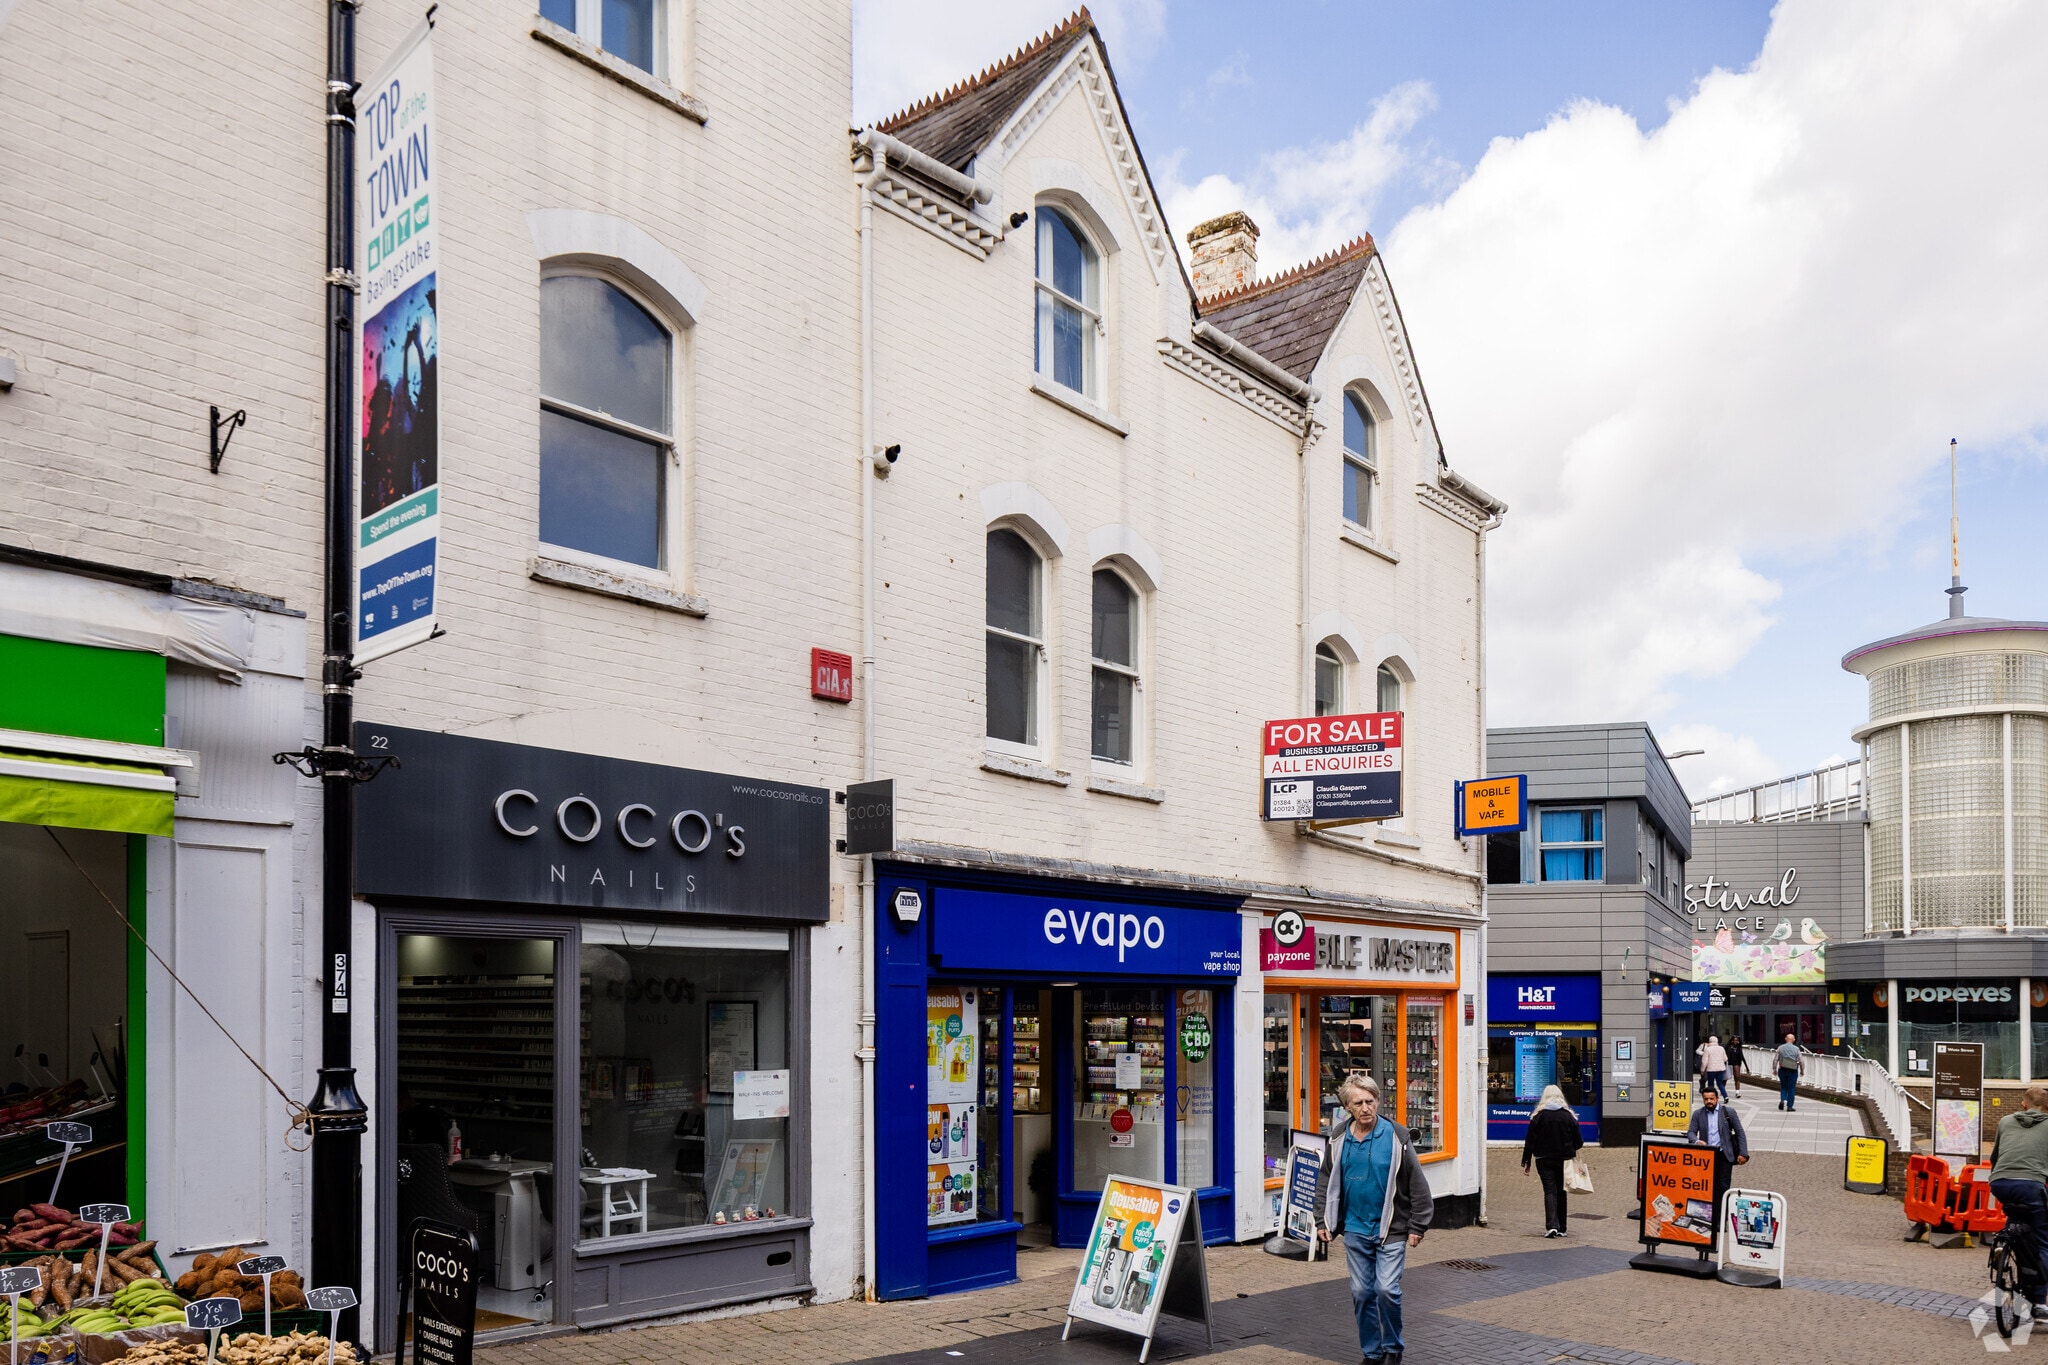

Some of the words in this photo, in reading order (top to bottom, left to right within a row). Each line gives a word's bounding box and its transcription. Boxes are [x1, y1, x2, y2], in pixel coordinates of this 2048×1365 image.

[365, 79, 400, 161] TOP
[400, 105, 410, 131] of
[411, 91, 427, 119] the
[367, 123, 429, 229] TOWN
[367, 240, 431, 304] Basingstoke
[369, 518, 389, 539] Spend
[389, 514, 400, 527] the
[400, 503, 427, 523] evening
[362, 564, 433, 601] www.TopOfTheTown.org
[817, 666, 841, 694] CIA
[1270, 723, 1321, 747] FOR
[1328, 718, 1395, 742] SALE
[371, 735, 388, 749] 22
[1285, 746, 1323, 756] BUSINESS
[1324, 743, 1378, 754] UNAFFECTED
[1271, 758, 1300, 774] ALL
[1304, 755, 1393, 772] ENQUIRIES
[732, 784, 823, 805] www.cocosnails.co
[1472, 786, 1511, 799] MOBILE
[1488, 799, 1496, 808] &
[493, 788, 746, 858] COCO's
[1479, 810, 1505, 820] VAPE
[853, 821, 886, 831] NAILS
[550, 864, 696, 892] NAILS
[900, 896, 917, 906] hns
[1698, 917, 1765, 931] LACE
[1043, 908, 1165, 962] evapo
[1210, 951, 1223, 959] your
[1224, 950, 1241, 959] local
[1267, 951, 1310, 965] payzone
[1369, 937, 1454, 972] MASTER
[336, 955, 346, 995] 374
[1203, 962, 1221, 973] vape
[1223, 961, 1241, 974] shop
[1518, 986, 1556, 1003] H&T
[1905, 986, 2012, 1002] POPEYES
[1084, 1002, 1131, 1011] Pre-Filled
[1187, 1015, 1205, 1023] Change
[1185, 1031, 1211, 1047] CBD
[1187, 1049, 1205, 1059] Today
[1658, 1091, 1686, 1100] CASH
[1657, 1109, 1687, 1119] GOLD
[1651, 1150, 1677, 1165] We
[1682, 1153, 1710, 1171] Buy
[1651, 1174, 1676, 1188] We
[1682, 1177, 1709, 1191] Sell
[1109, 1191, 1159, 1215] Reusable
[421, 1278, 459, 1298] NAILS
[423, 1316, 436, 1328] NAILS
[436, 1321, 462, 1337] EXTENSION
[423, 1330, 439, 1343] OMBRE
[439, 1336, 453, 1348] NAILS
[423, 1343, 431, 1354] SPA
[431, 1347, 455, 1363] PEDICURE
